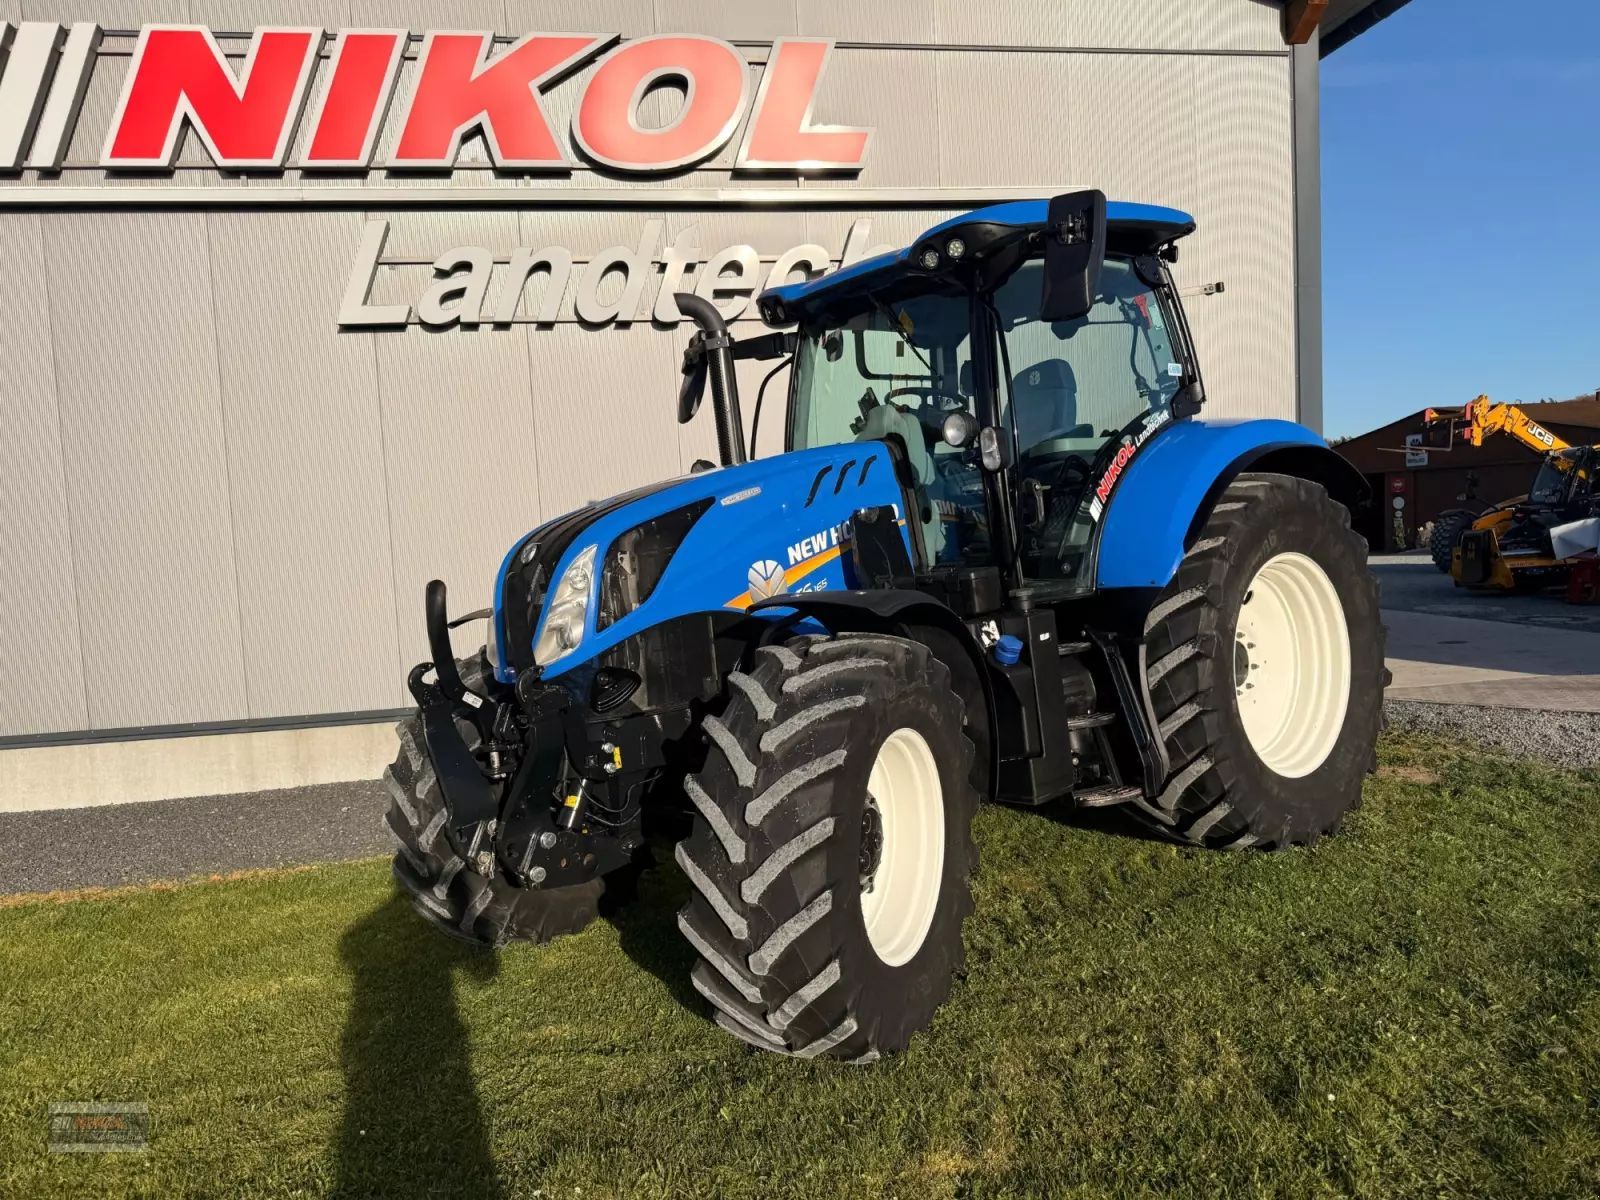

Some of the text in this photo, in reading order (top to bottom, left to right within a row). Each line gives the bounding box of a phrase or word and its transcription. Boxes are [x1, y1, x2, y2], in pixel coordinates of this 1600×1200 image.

[100, 25, 874, 173] NIKOL
[1528, 424, 1555, 446] JCB
[1096, 440, 1137, 504] NIKOL
[787, 530, 828, 565] NEW
